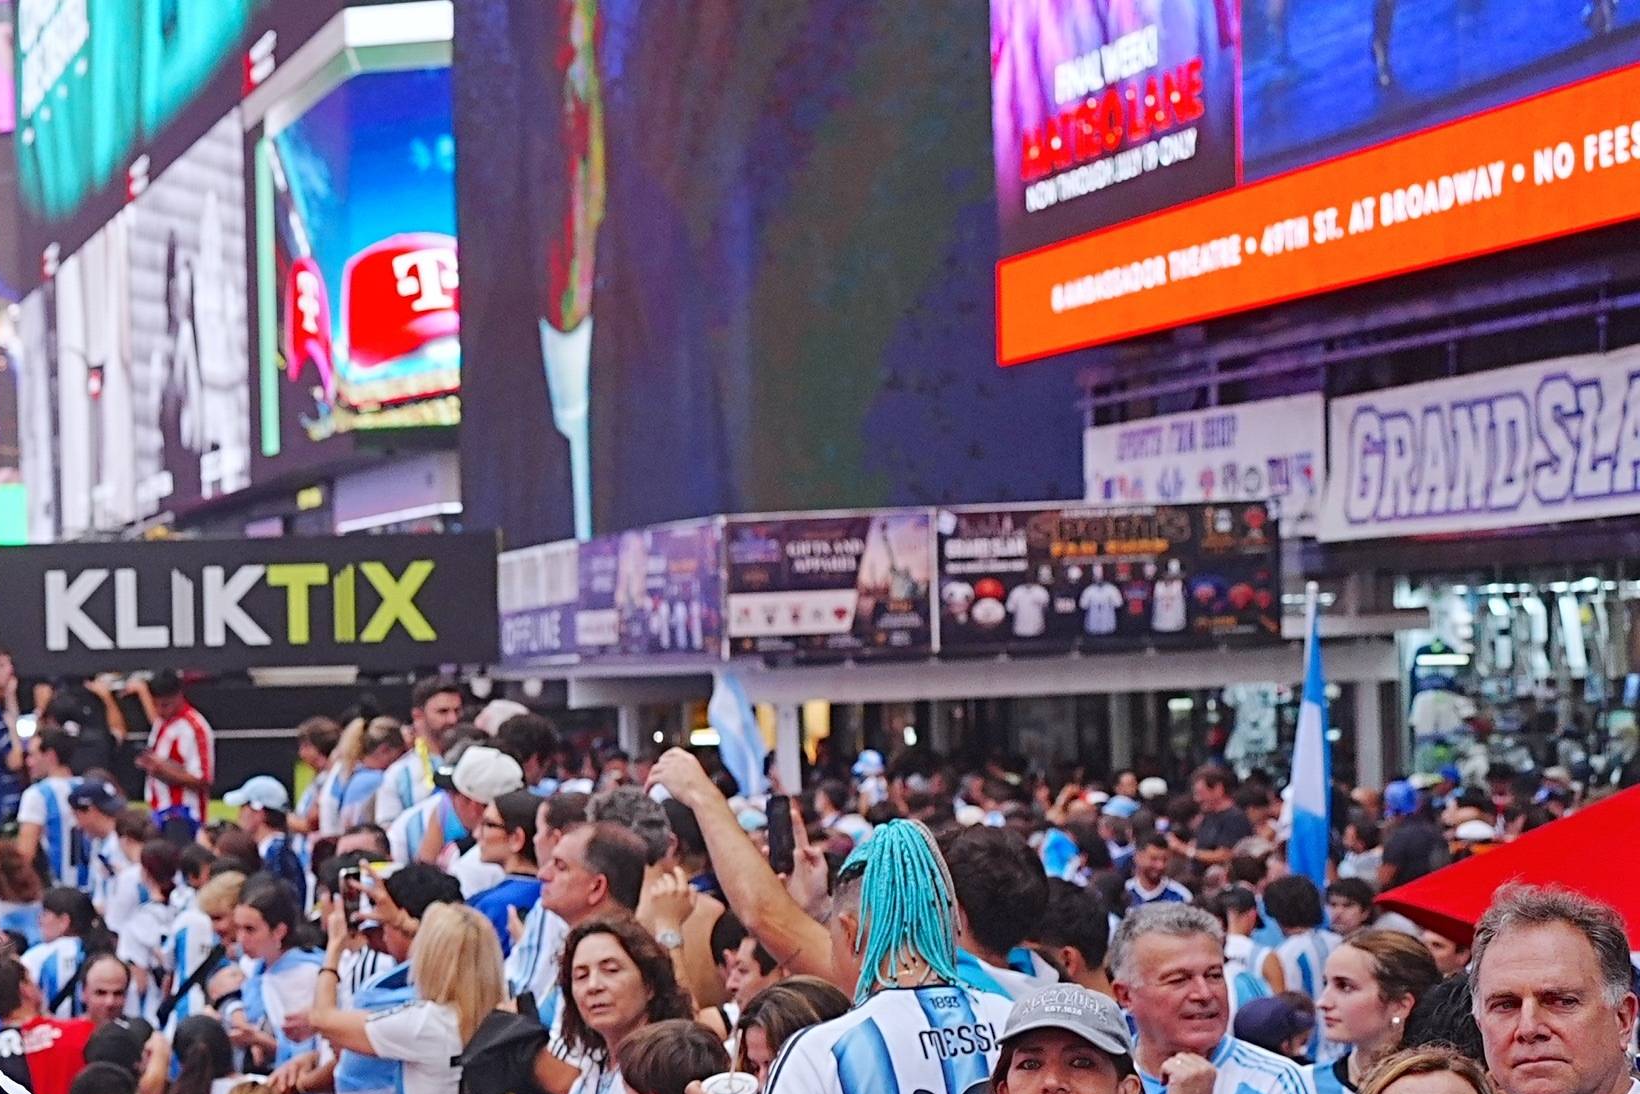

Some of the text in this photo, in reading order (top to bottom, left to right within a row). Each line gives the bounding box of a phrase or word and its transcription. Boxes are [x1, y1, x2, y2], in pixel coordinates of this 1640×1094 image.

[1313, 207, 1345, 244] ST.
[1349, 197, 1376, 235] AT
[1380, 160, 1506, 227] BROADWAY
[1533, 141, 1576, 186] NO
[1583, 119, 1640, 173] FEES
[44, 559, 438, 651] KLIKTIX
[931, 995, 961, 1010] 1893
[918, 1022, 1000, 1061] MESSI
